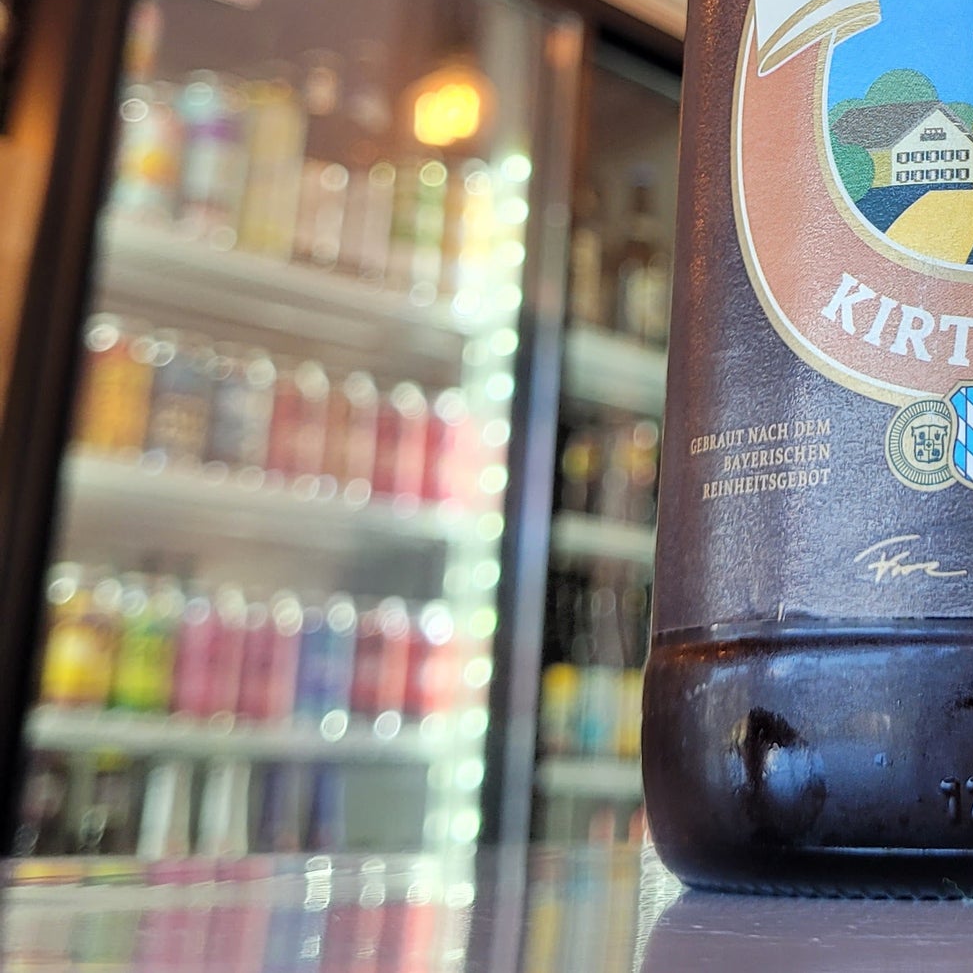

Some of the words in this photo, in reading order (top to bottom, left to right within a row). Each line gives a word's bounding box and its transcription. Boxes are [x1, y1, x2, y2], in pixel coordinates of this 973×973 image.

[690, 429, 745, 455] GEBRAUT
[747, 423, 789, 444] NACH
[793, 418, 831, 439] DEM
[724, 443, 831, 471] BAYERISCHEN
[703, 468, 831, 500] REINHEITSGEBOT
